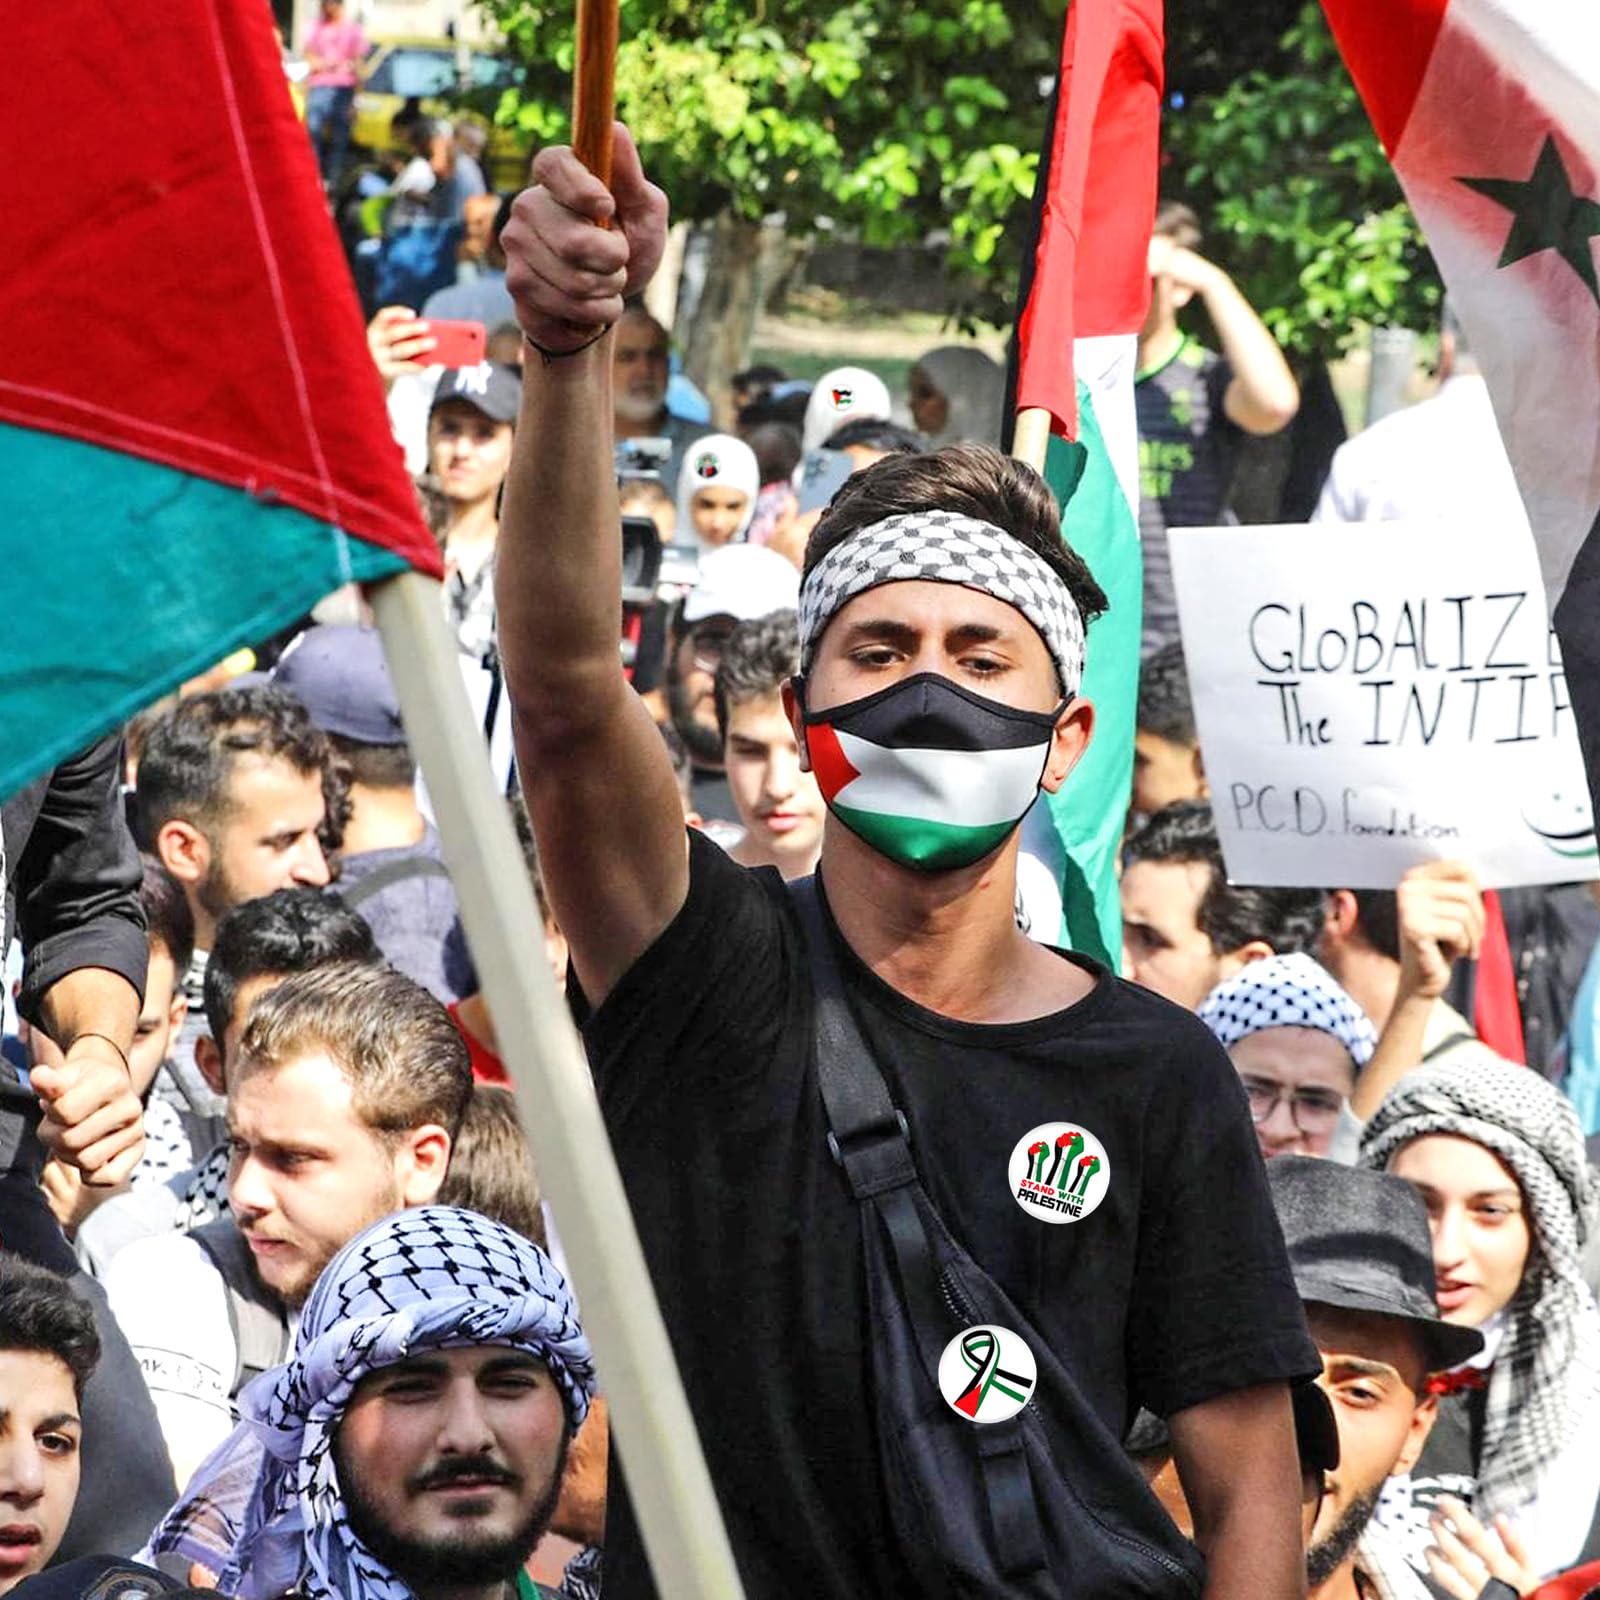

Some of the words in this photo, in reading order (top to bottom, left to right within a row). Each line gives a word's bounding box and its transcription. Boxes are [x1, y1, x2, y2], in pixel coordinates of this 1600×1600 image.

[1257, 680, 1332, 746] The
[1017, 1188, 1082, 1218] PALESTINE
[1020, 1179, 1055, 1196] STAND
[1058, 1191, 1085, 1206] WITH
